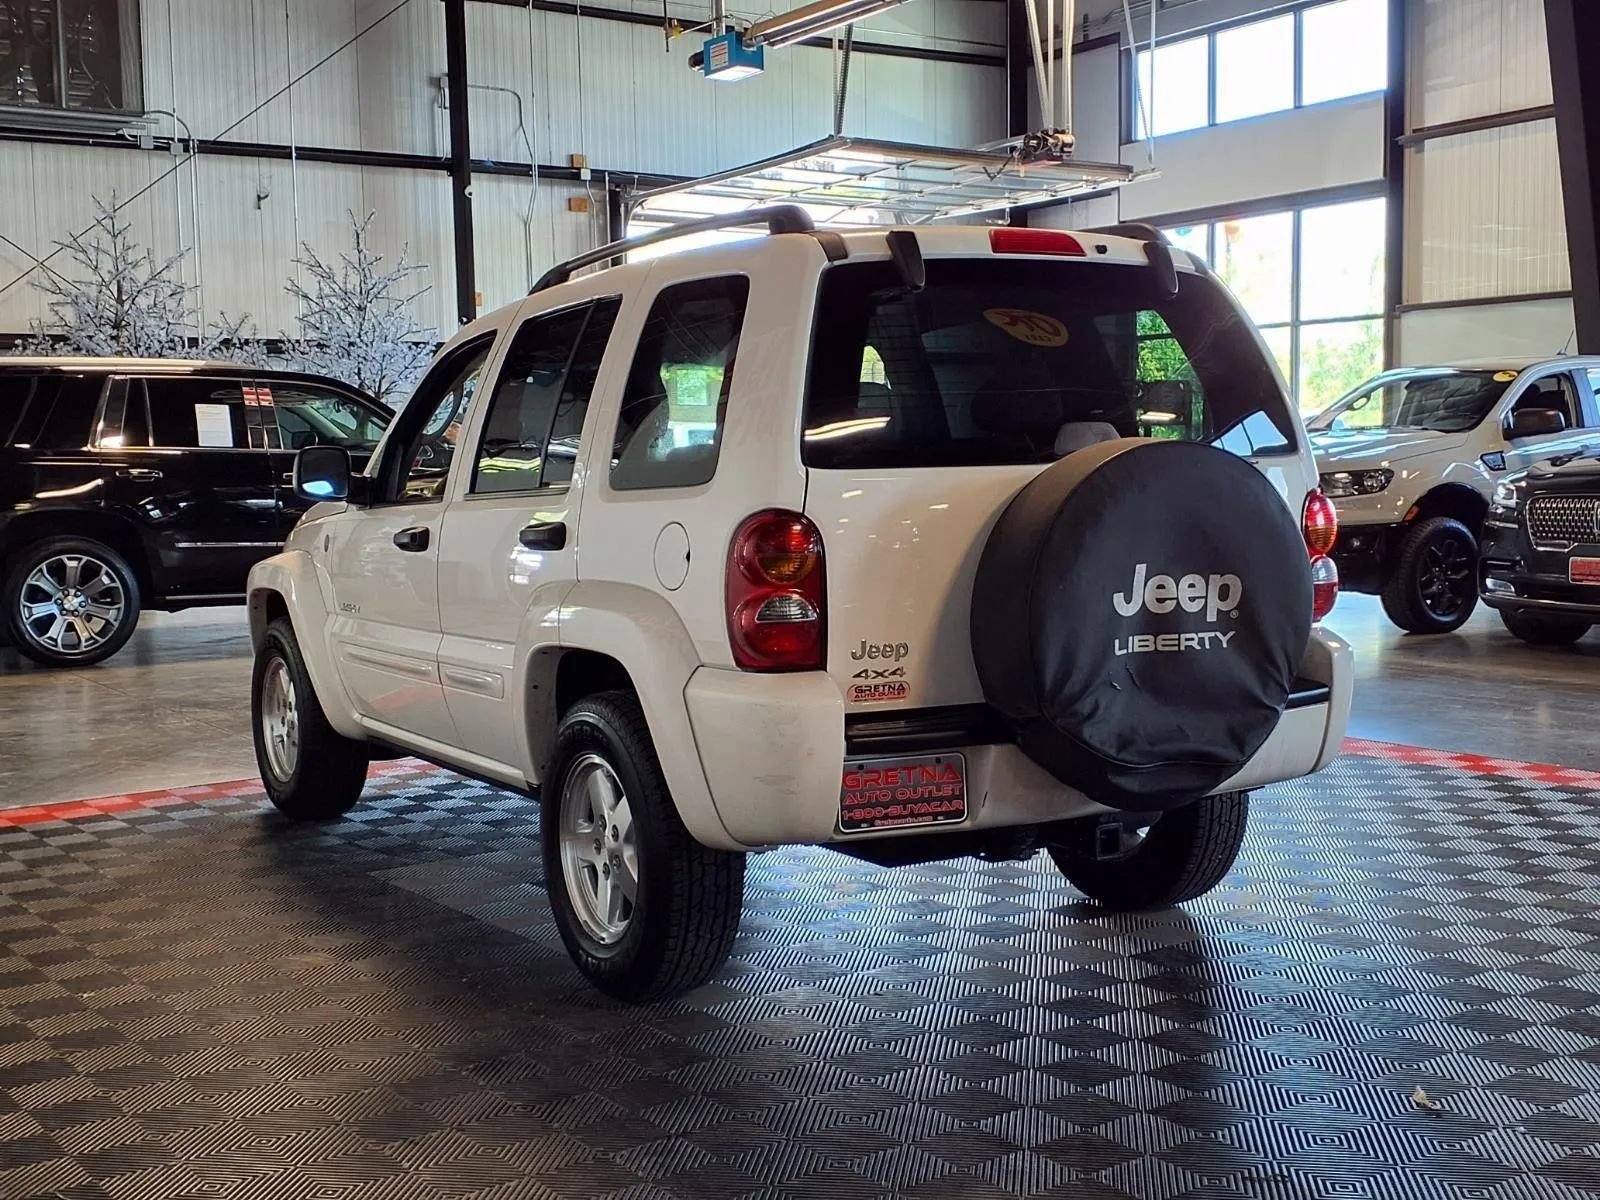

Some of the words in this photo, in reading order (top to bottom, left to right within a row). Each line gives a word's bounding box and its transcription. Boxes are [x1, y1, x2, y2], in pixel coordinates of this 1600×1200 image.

[1113, 563, 1242, 622] Jeep
[851, 639, 909, 662] Jeep
[1114, 630, 1236, 656] LIBERTY
[854, 683, 906, 694] GRETNA
[878, 690, 906, 698] OUTLET
[843, 763, 961, 790] GRETNA
[843, 790, 891, 805] AUTO
[895, 783, 963, 801] OUTLET
[843, 800, 963, 820] 1-800-BUYACAR
